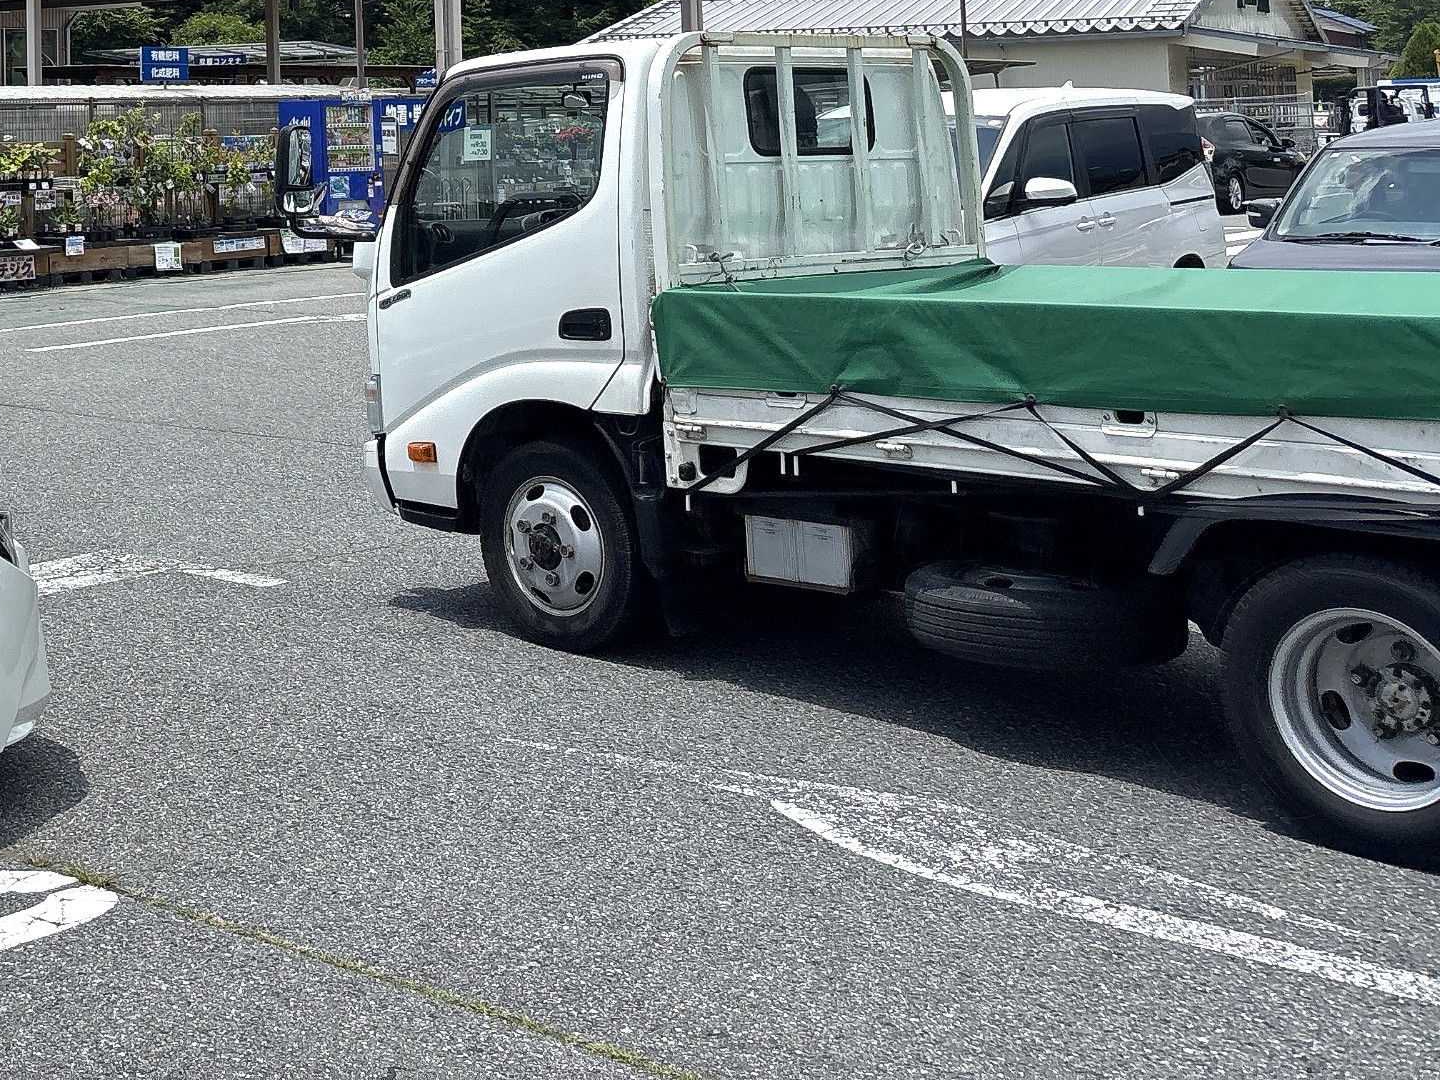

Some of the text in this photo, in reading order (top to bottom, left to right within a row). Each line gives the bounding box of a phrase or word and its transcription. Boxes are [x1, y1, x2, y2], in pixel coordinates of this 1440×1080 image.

[150, 50, 180, 61] 有機肥料
[151, 67, 180, 78] 化成肥料
